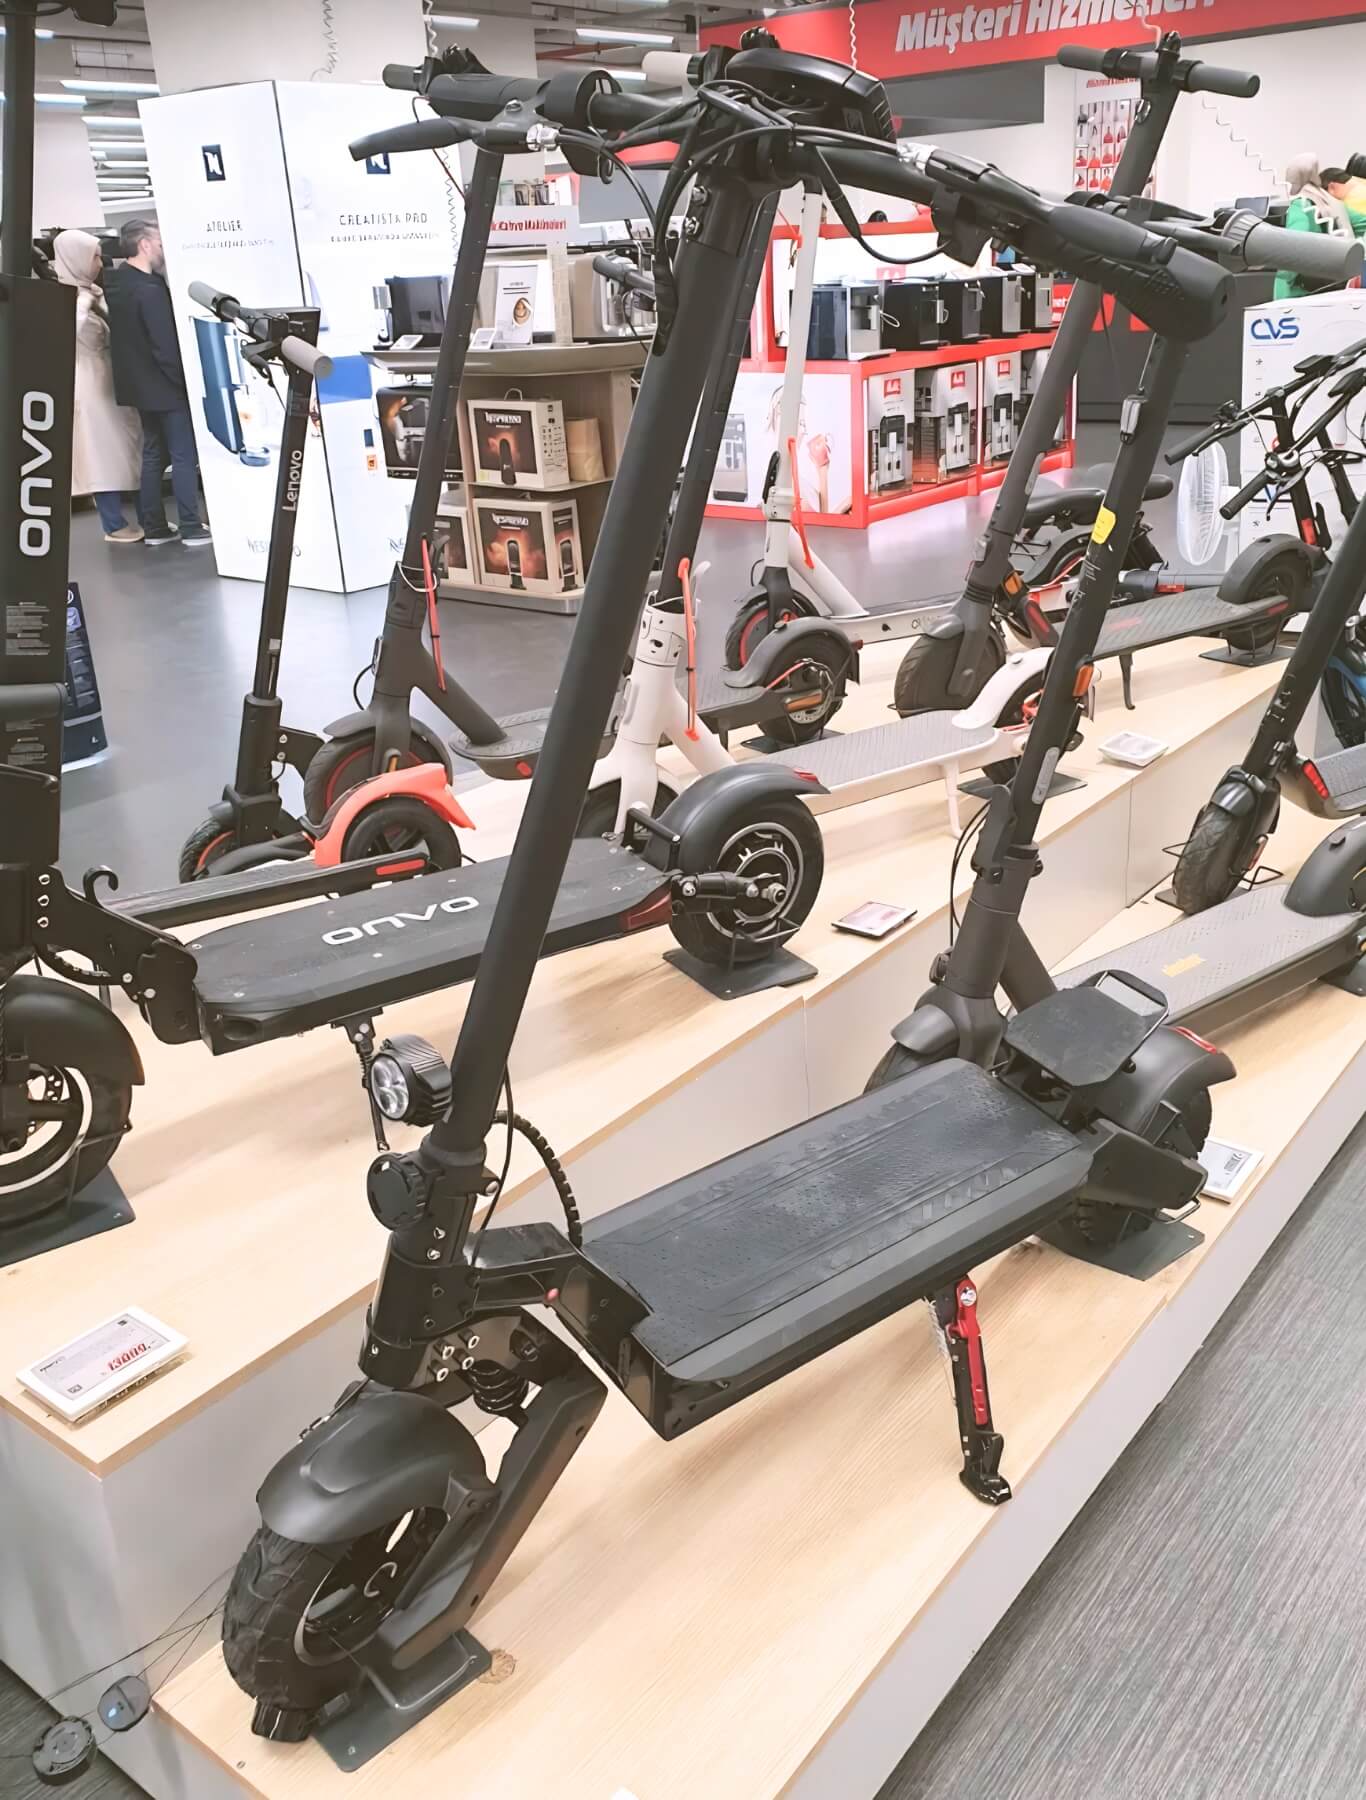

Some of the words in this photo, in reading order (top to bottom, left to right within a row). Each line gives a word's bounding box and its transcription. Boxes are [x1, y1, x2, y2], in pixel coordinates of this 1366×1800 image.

[895, 0, 1021, 53] Müşteri
[1025, 0, 1213, 34] Hizmet
[1250, 317, 1300, 340] CVS
[282, 450, 303, 512] Lenovo
